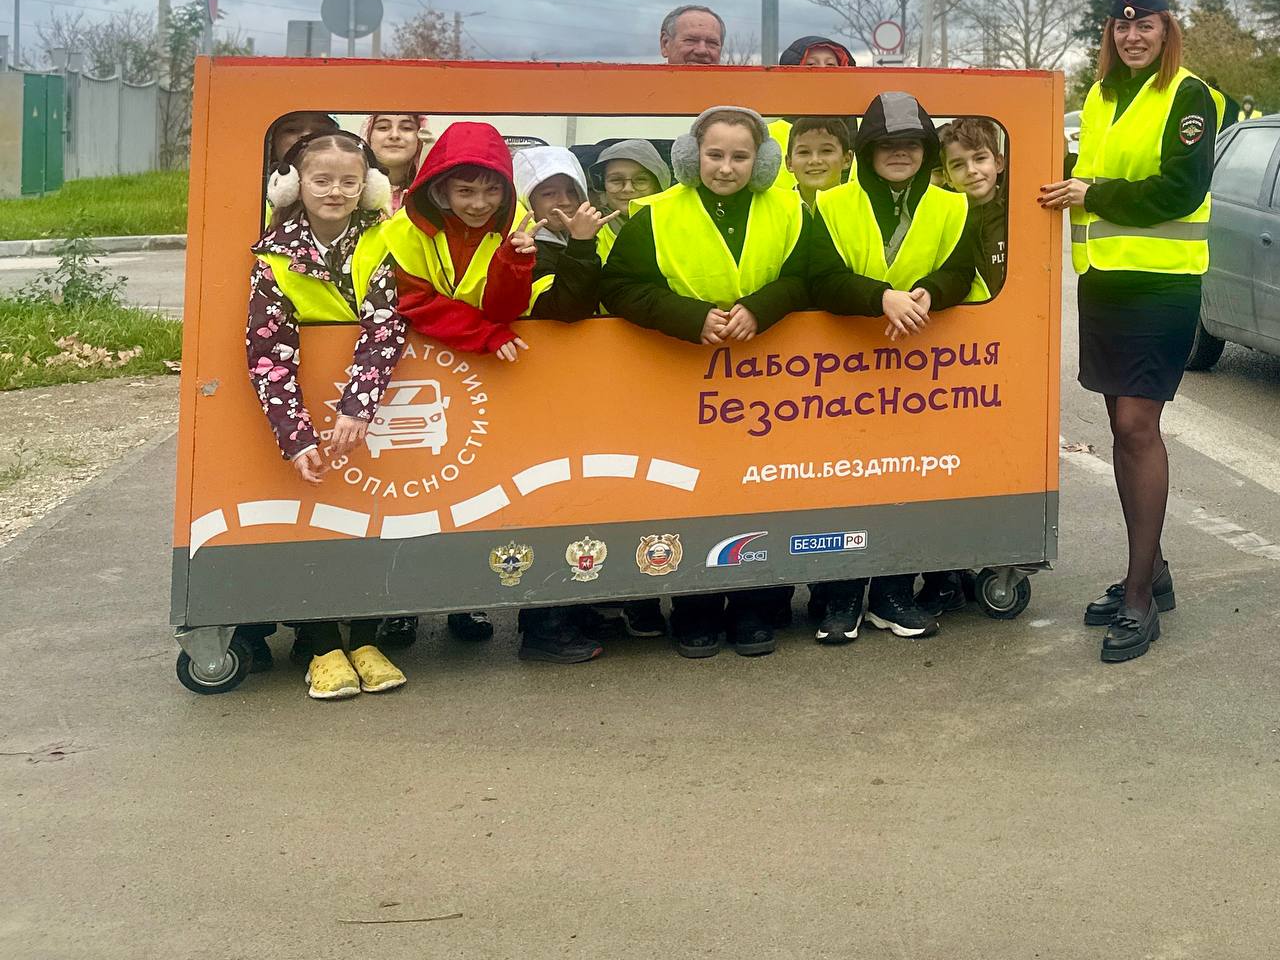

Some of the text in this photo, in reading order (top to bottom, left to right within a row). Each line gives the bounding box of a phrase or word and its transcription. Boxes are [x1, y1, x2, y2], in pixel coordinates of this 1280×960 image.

[703, 342, 1001, 387] Лаборатория
[698, 384, 1002, 437] Безопасности
[742, 453, 961, 484] дети.бездтп.рф
[794, 535, 864, 550] БЕЗДТП РФ
